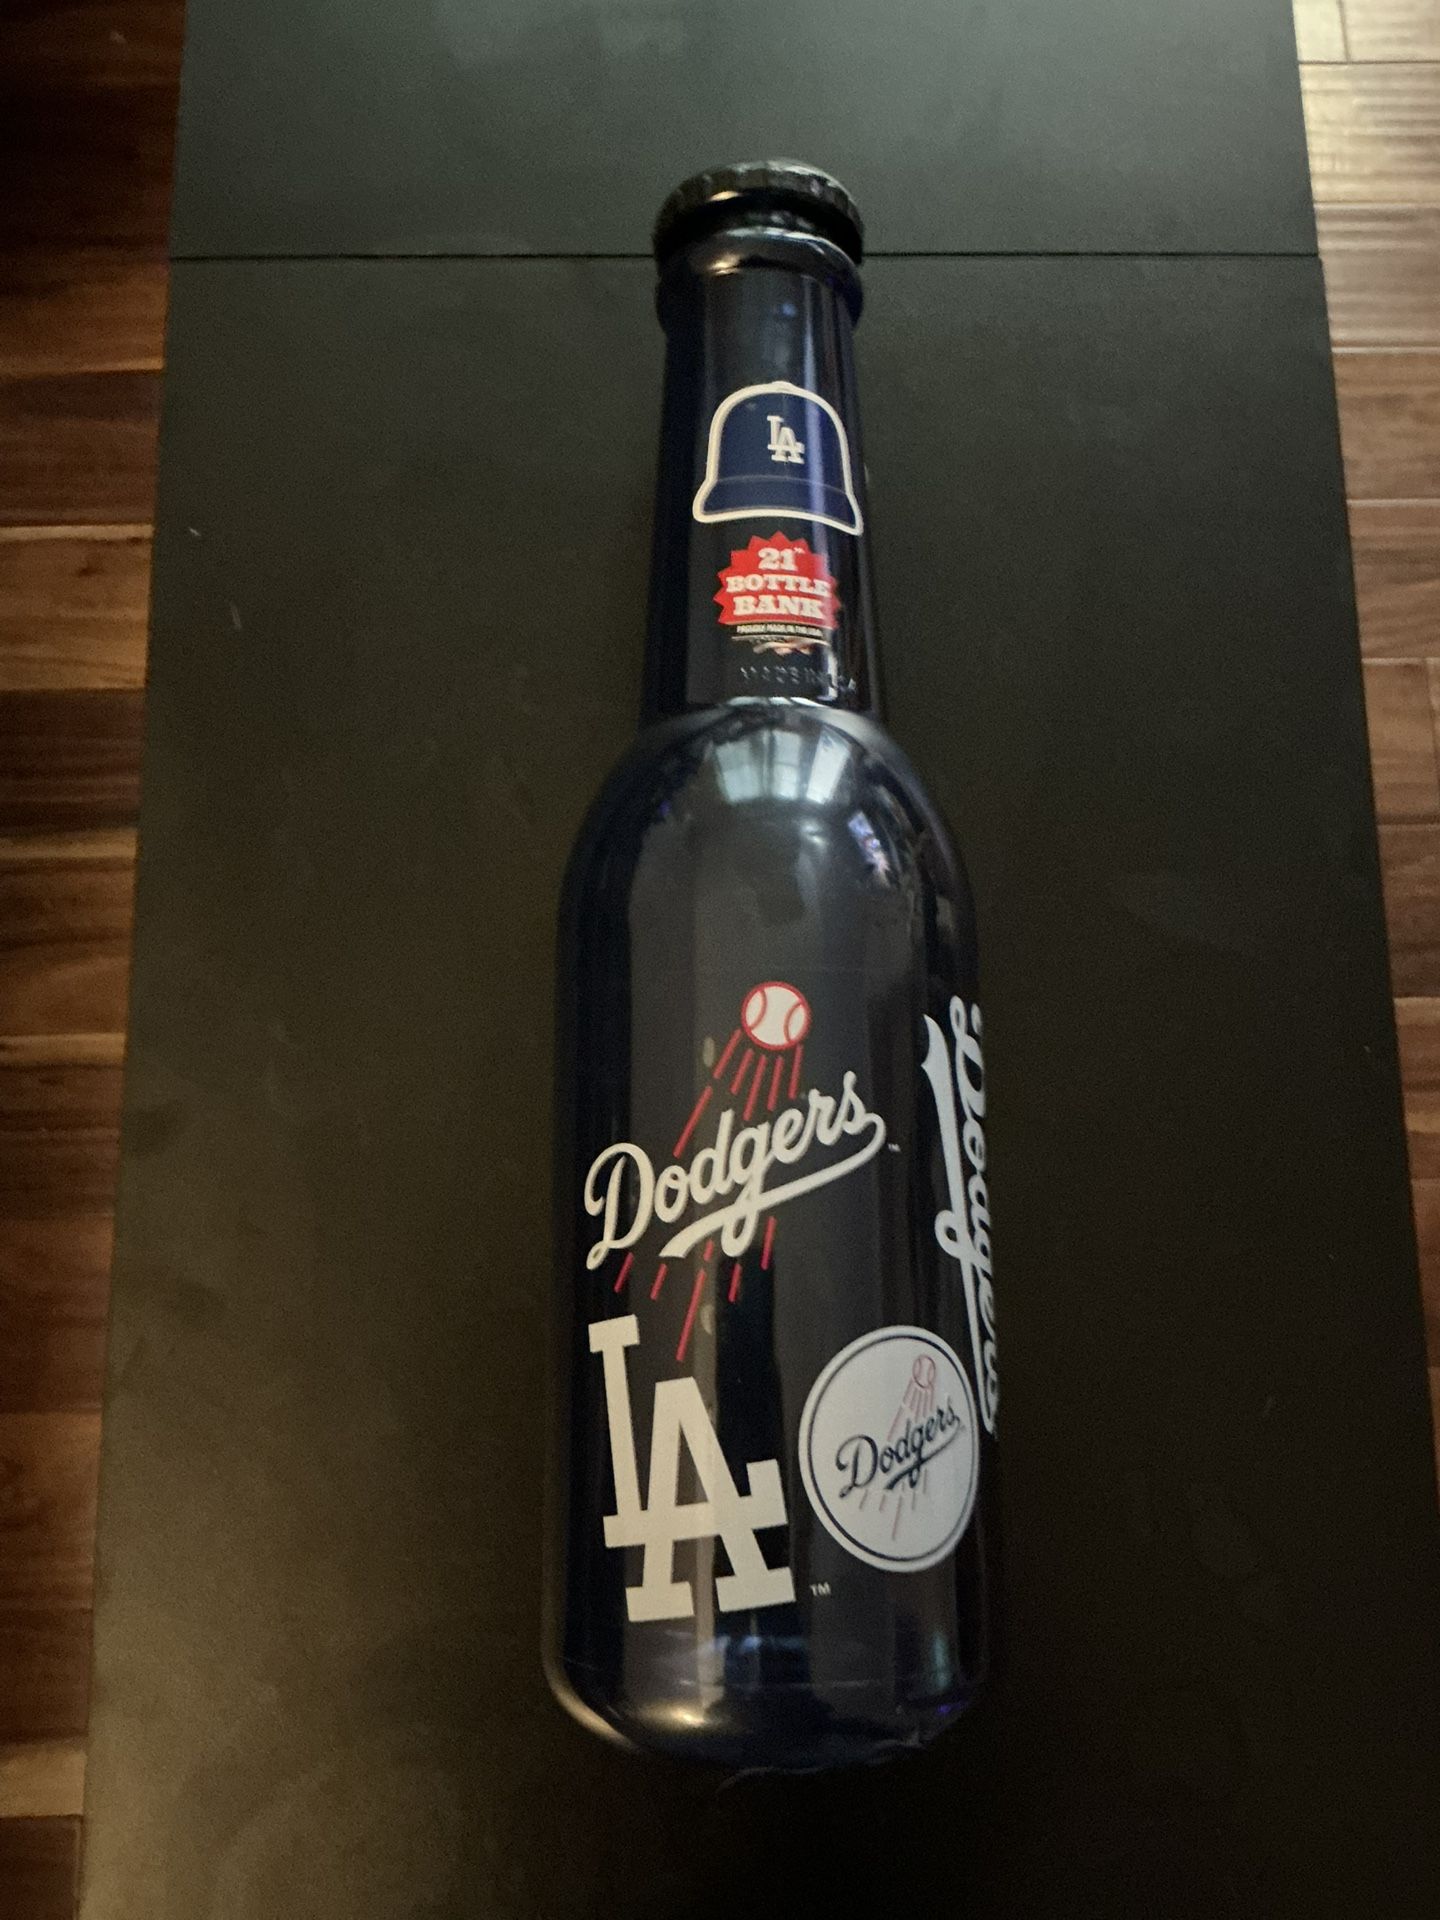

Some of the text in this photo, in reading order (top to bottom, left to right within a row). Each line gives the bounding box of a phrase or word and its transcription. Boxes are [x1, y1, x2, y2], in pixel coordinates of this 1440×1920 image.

[766, 415, 805, 464] LA
[726, 574, 831, 598] BOTTLE
[733, 595, 826, 620] BANK
[584, 1070, 887, 1270] Dodgers
[588, 1314, 796, 1623] LA
[835, 1396, 961, 1498] Dodgers
[810, 1583, 832, 1597] TM
